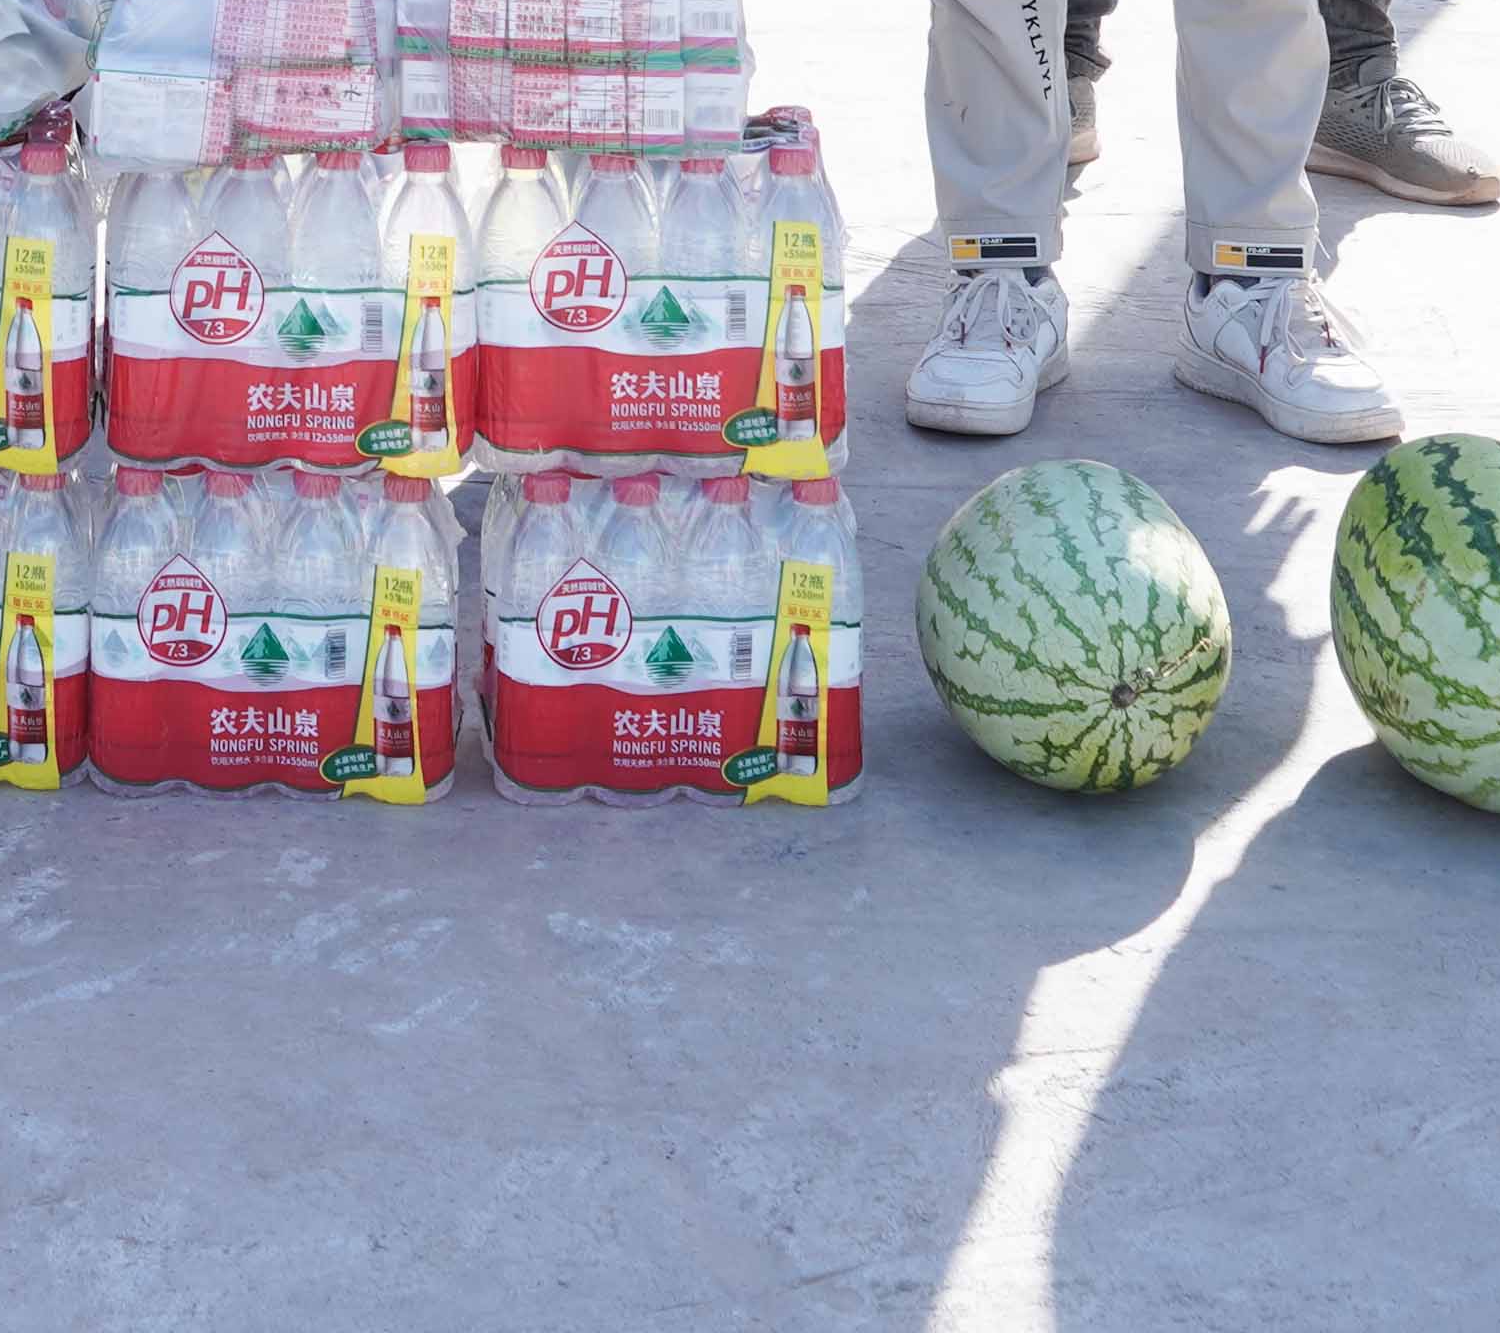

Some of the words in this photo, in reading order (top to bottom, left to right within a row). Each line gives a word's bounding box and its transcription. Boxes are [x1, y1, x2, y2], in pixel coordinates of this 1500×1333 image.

[544, 259, 613, 309] pH
[183, 271, 251, 318] pH
[565, 309, 587, 323] 7.3
[203, 321, 224, 335] 7.3
[610, 372, 721, 399] 农夫山泉
[248, 383, 355, 412] 农夫山泉
[611, 404, 665, 417] NONGFU
[671, 404, 720, 417] SPRING
[248, 414, 300, 429] NONGFU
[306, 414, 354, 429] SPRING
[550, 597, 619, 649] pH
[167, 643, 188, 657] 7.3
[570, 647, 592, 661] 7.3
[210, 707, 319, 737] 农夫山泉
[613, 709, 722, 737] 农夫山泉
[210, 739, 263, 752] NONGFU
[270, 739, 318, 753] SPRING
[613, 741, 665, 754] NONGFU
[671, 740, 721, 755] SPRING
